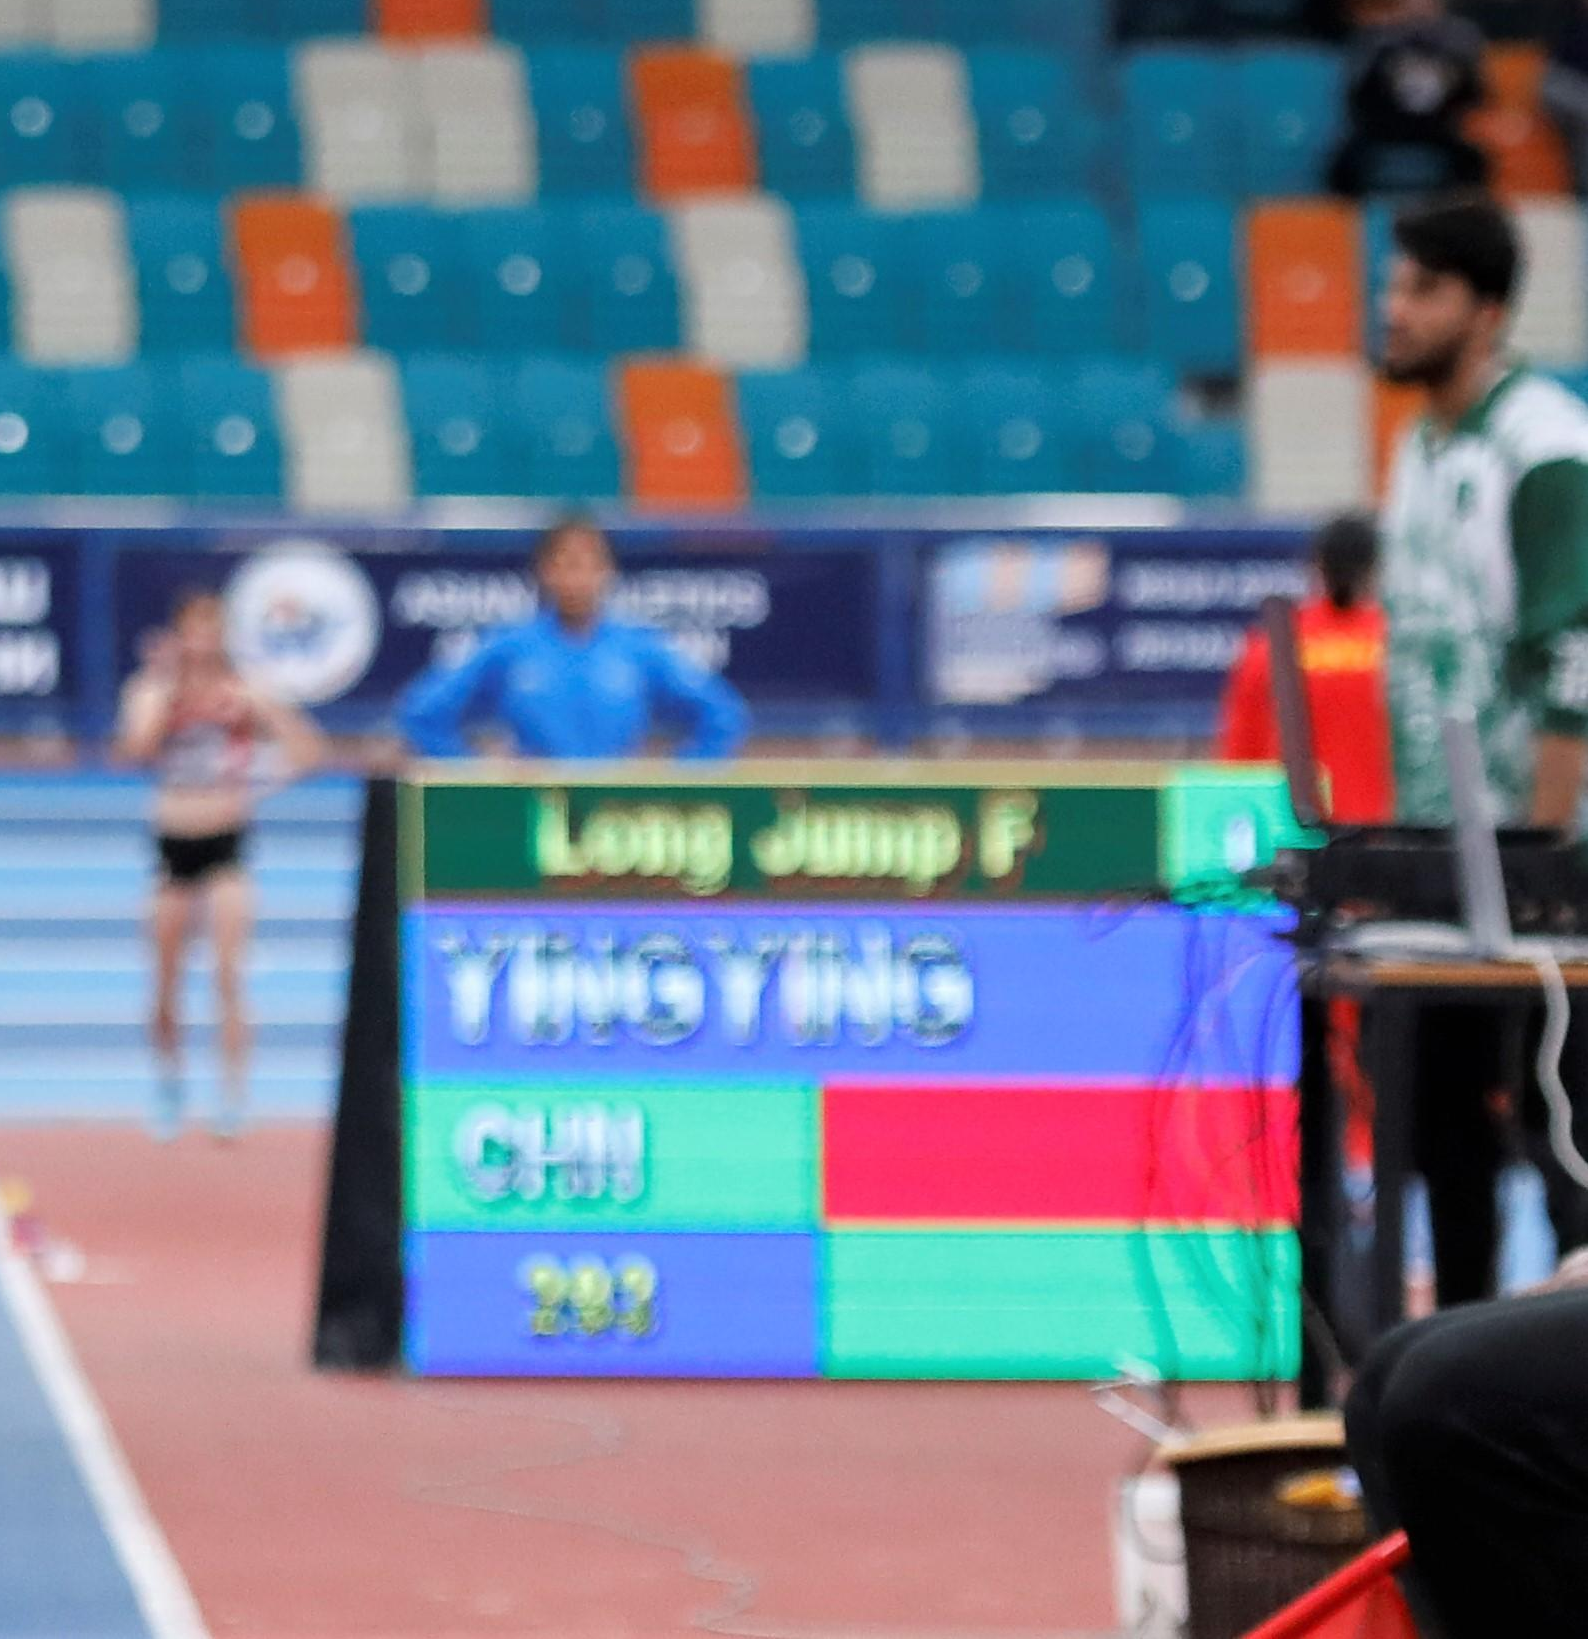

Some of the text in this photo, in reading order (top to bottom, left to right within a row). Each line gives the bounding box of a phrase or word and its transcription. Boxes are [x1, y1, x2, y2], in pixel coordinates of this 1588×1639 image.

[536, 789, 733, 896] Long
[750, 789, 961, 896] Jump
[457, 1104, 645, 1202] CHN
